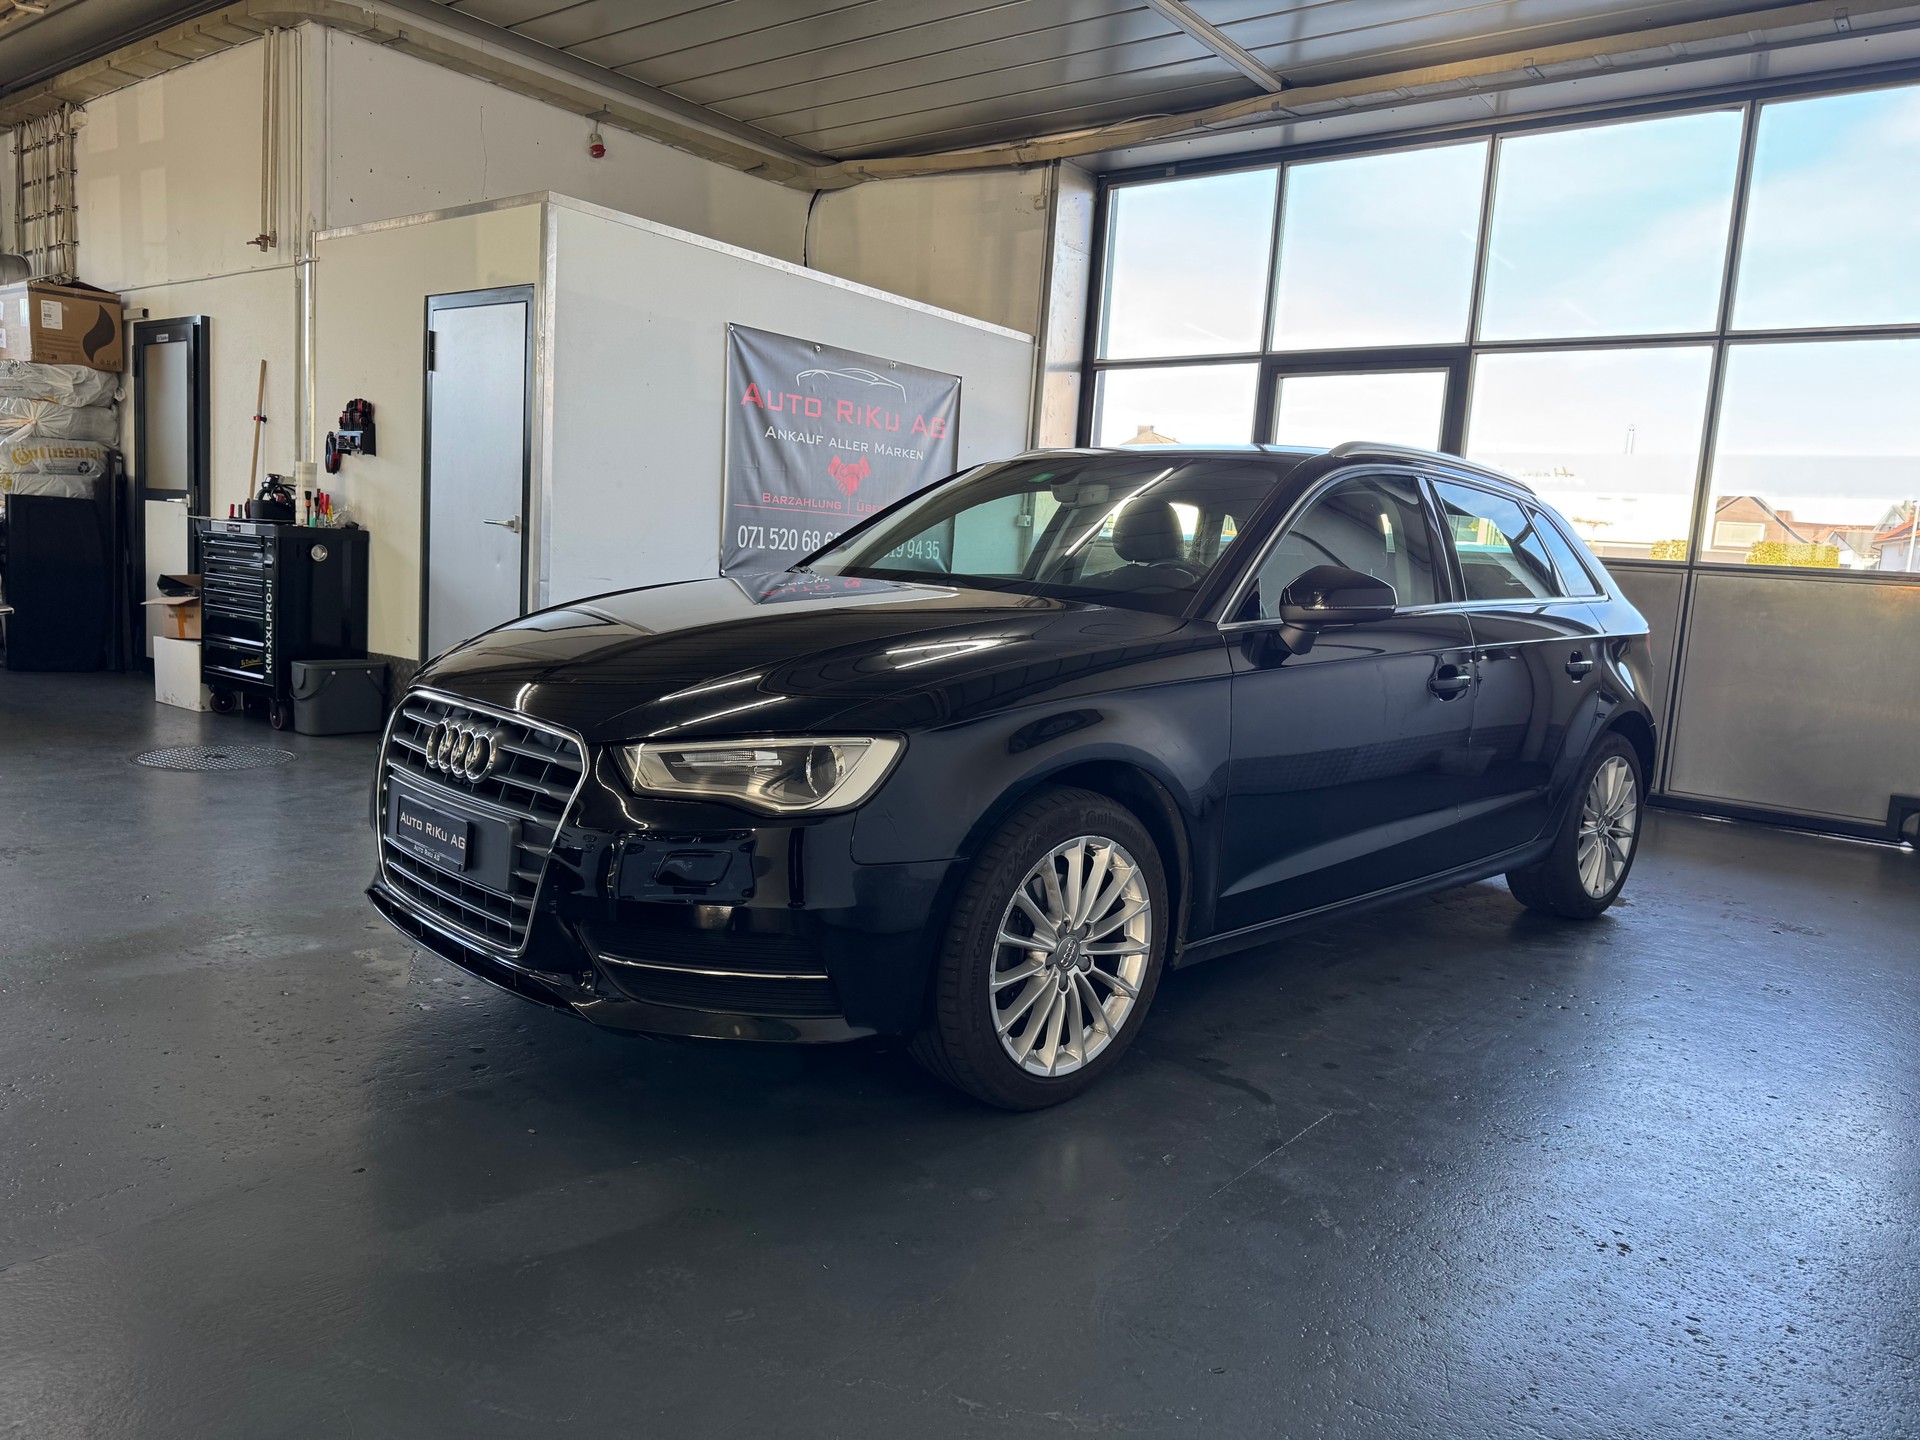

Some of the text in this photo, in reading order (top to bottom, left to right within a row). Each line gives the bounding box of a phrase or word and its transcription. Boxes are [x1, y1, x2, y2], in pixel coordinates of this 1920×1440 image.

[911, 415, 946, 439] AG
[12, 445, 100, 466] Continental
[737, 525, 765, 549] 071
[769, 528, 798, 551] 520
[802, 530, 821, 551] 68
[907, 540, 923, 559] 94
[925, 540, 940, 560] 35
[450, 834, 466, 850] AG
